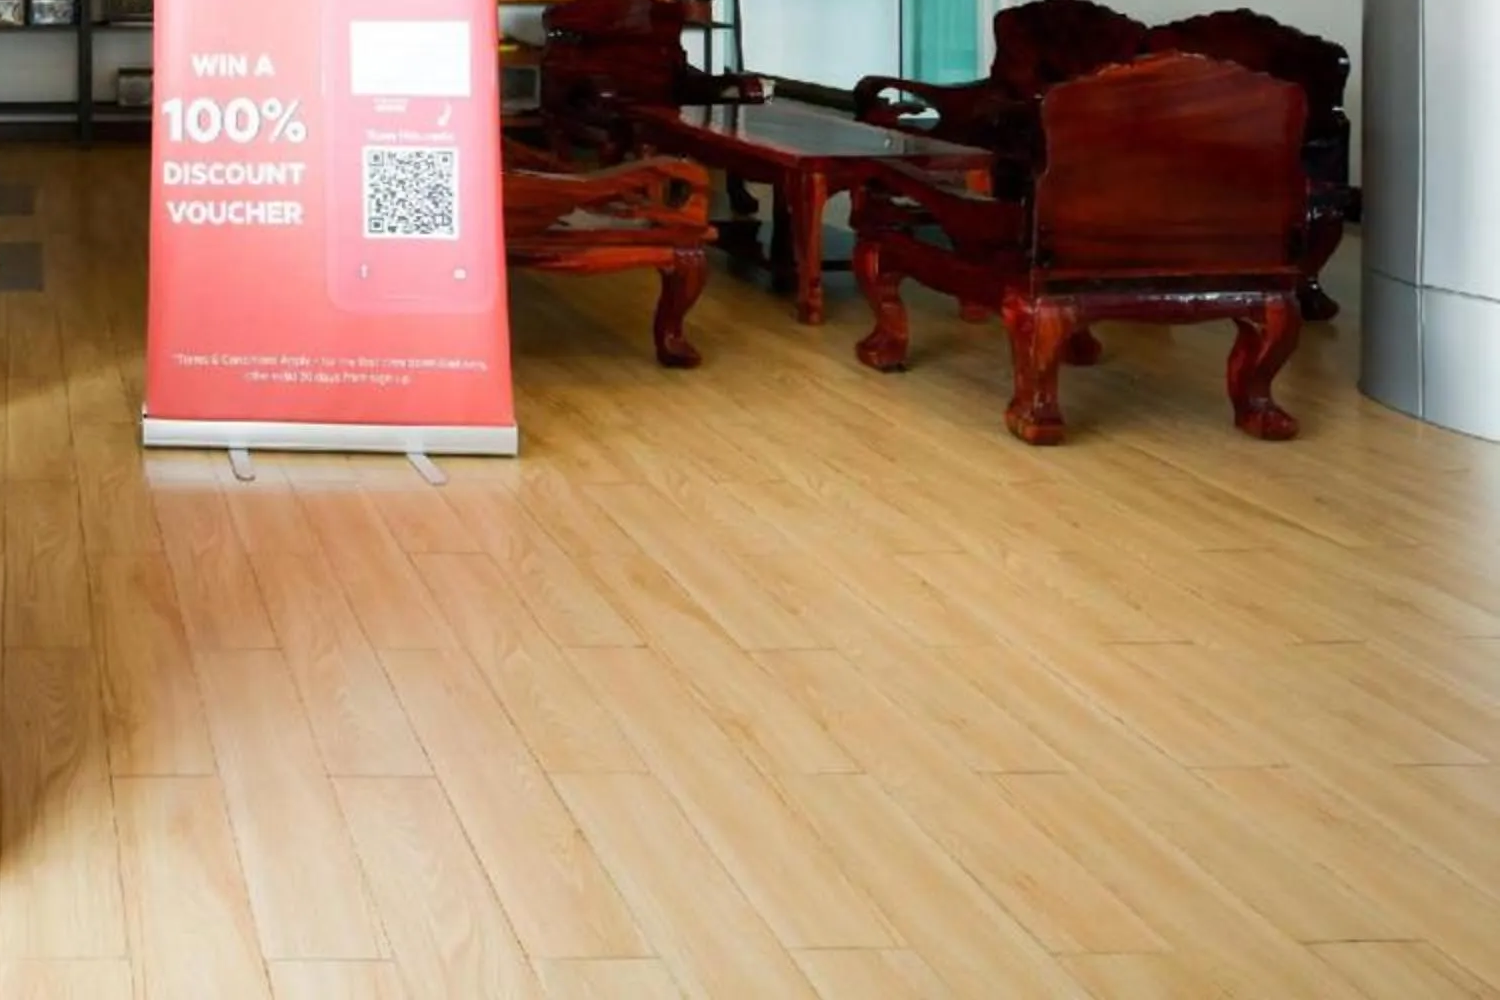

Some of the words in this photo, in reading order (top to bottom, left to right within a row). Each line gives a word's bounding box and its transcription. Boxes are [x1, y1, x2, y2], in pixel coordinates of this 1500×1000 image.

[191, 53, 247, 77] WIN
[253, 53, 275, 76] A
[162, 97, 307, 144] 100%
[163, 161, 306, 187] DISCOUNT
[165, 199, 304, 226] VOUCHER
